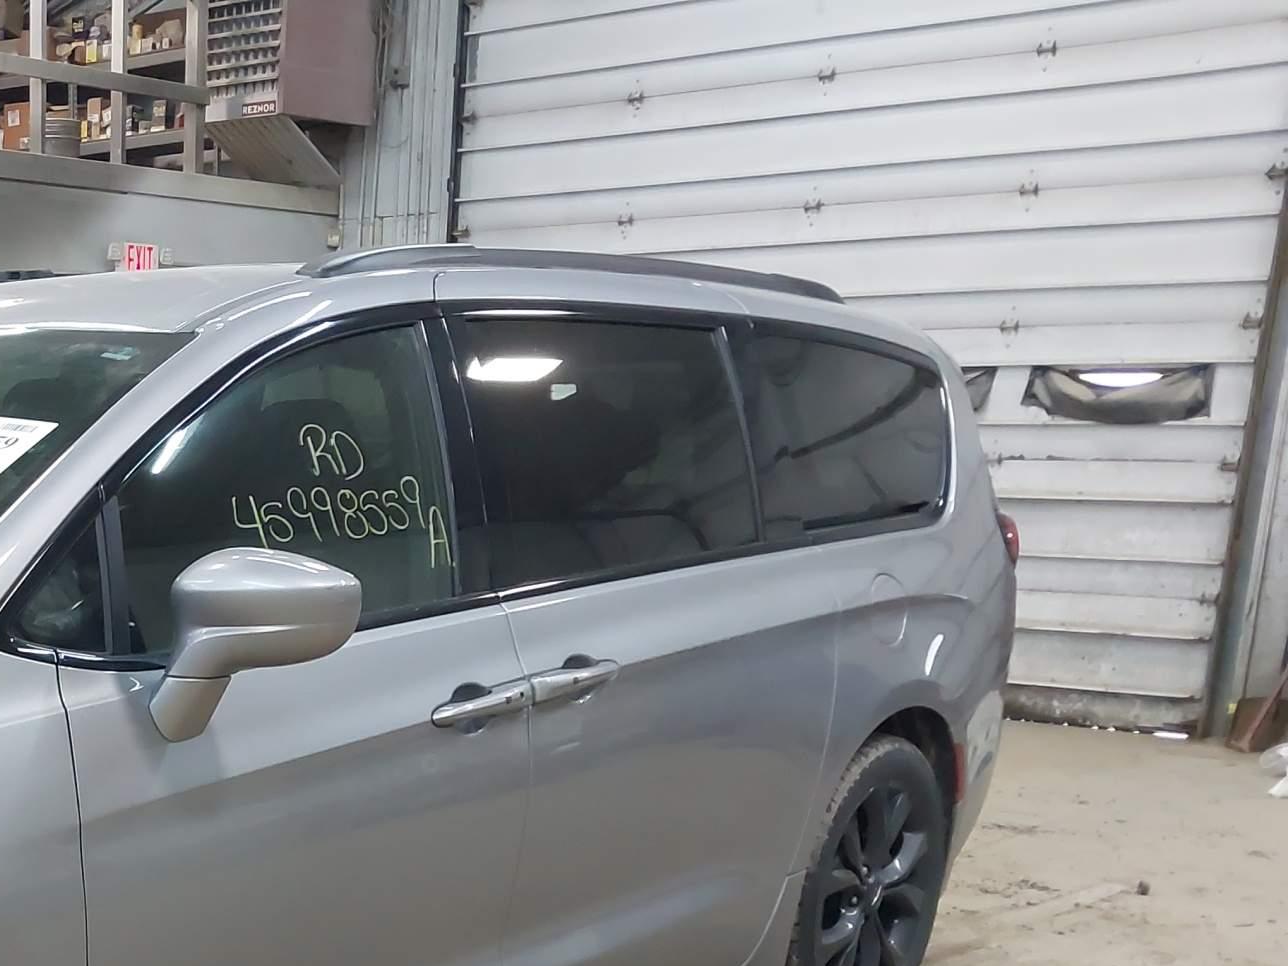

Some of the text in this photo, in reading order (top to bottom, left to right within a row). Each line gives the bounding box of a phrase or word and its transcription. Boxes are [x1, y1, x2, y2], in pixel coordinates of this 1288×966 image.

[242, 103, 275, 115] REZNOR
[128, 244, 154, 270] EXIT
[299, 423, 364, 480] RD
[232, 475, 454, 568] 45998559 A
